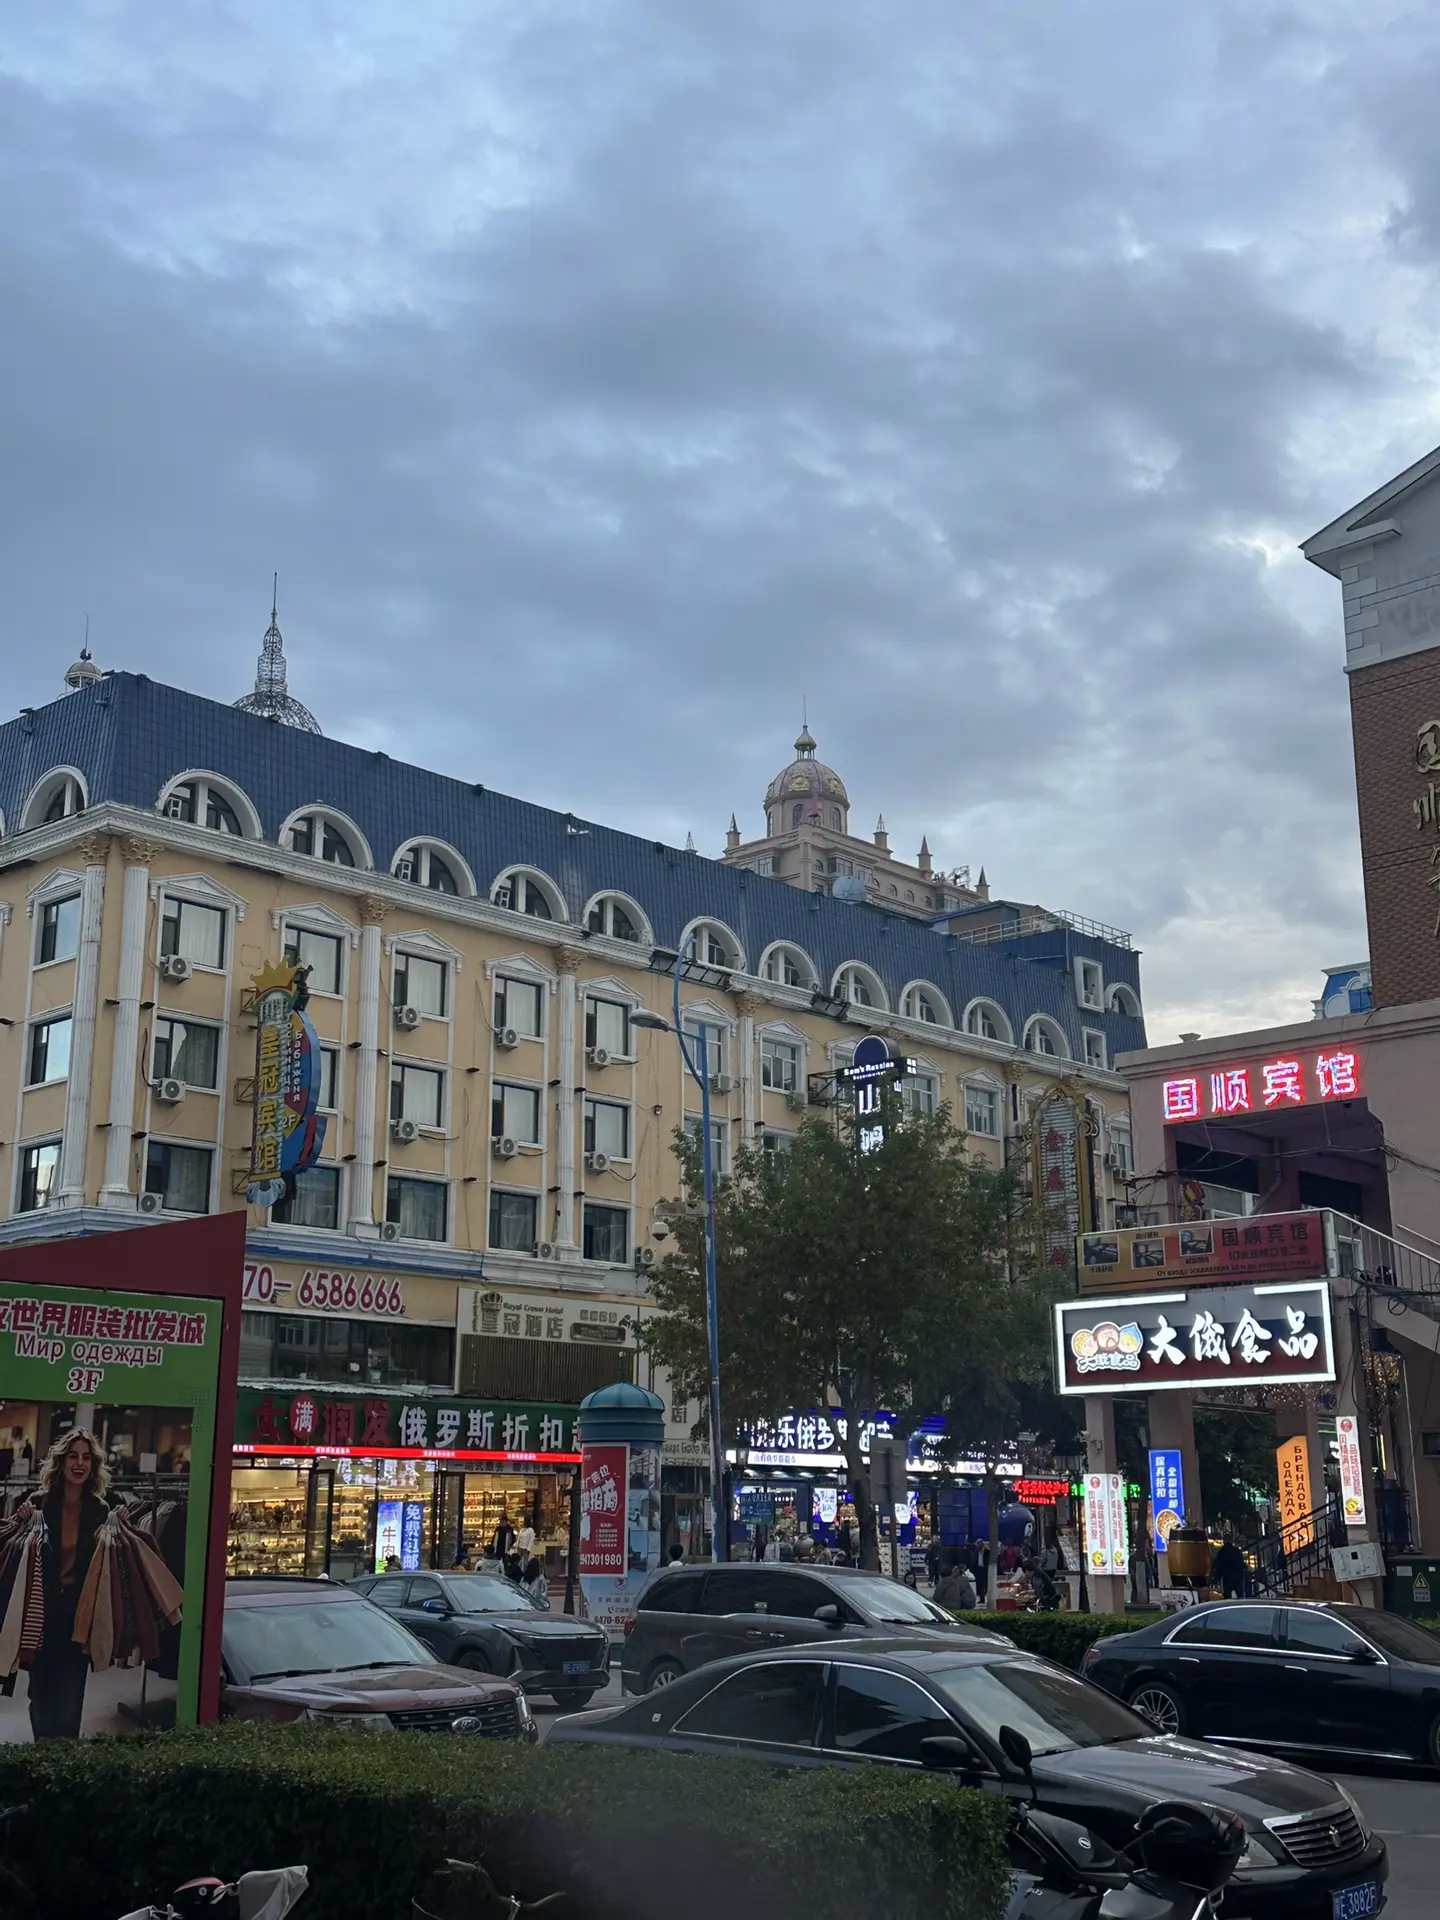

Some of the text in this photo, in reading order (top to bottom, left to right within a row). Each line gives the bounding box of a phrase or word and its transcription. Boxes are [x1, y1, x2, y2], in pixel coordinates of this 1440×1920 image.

[257, 1024, 280, 1170] 皇冠宾馆
[1162, 1052, 1356, 1120] 国顺宾馆
[282, 1115, 296, 1130] 2F
[16, 1334, 163, 1367] Мир одежды
[68, 1369, 103, 1394] 3F
[1283, 1460, 1296, 1517] ОДЕЖДА
[402, 1504, 421, 1570] 免费包邮
